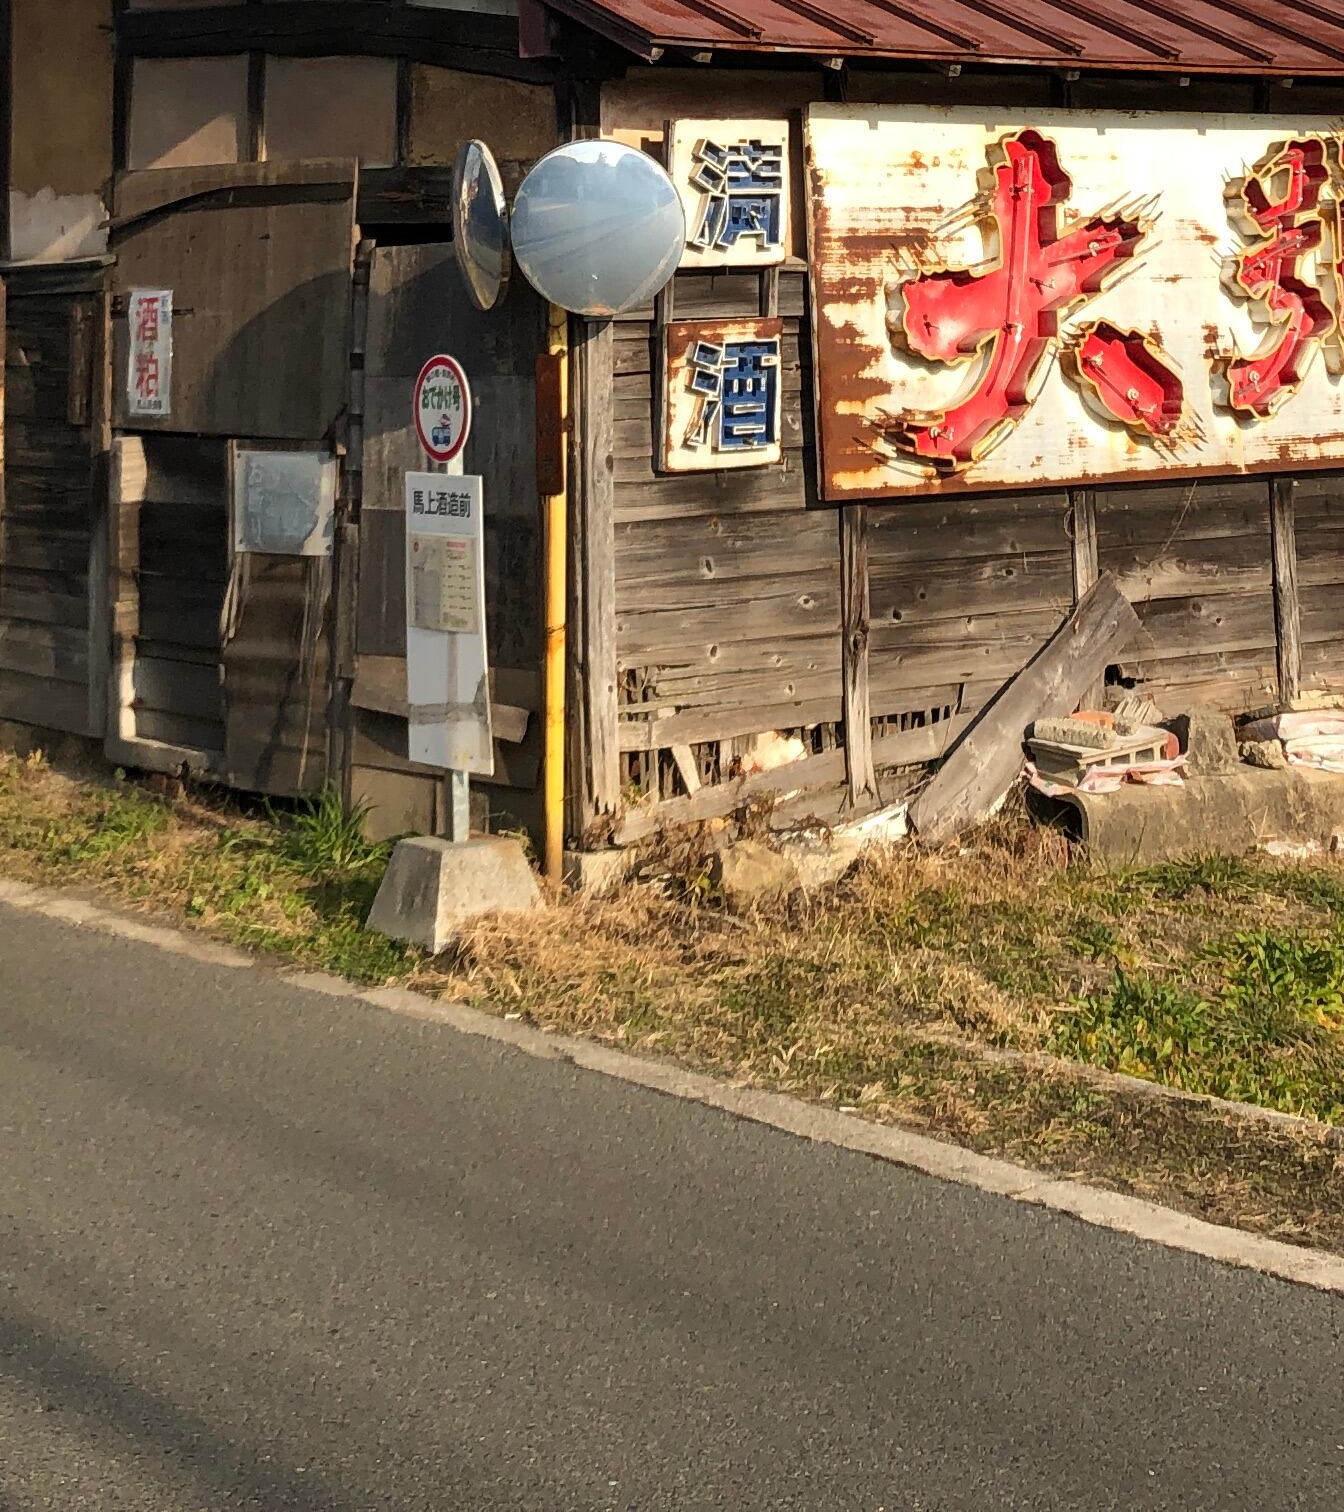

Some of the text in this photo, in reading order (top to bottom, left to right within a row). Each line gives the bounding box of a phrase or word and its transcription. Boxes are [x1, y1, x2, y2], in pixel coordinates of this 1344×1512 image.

[422, 385, 460, 411] おでかけ号
[413, 490, 471, 518] 馬上酒造前
